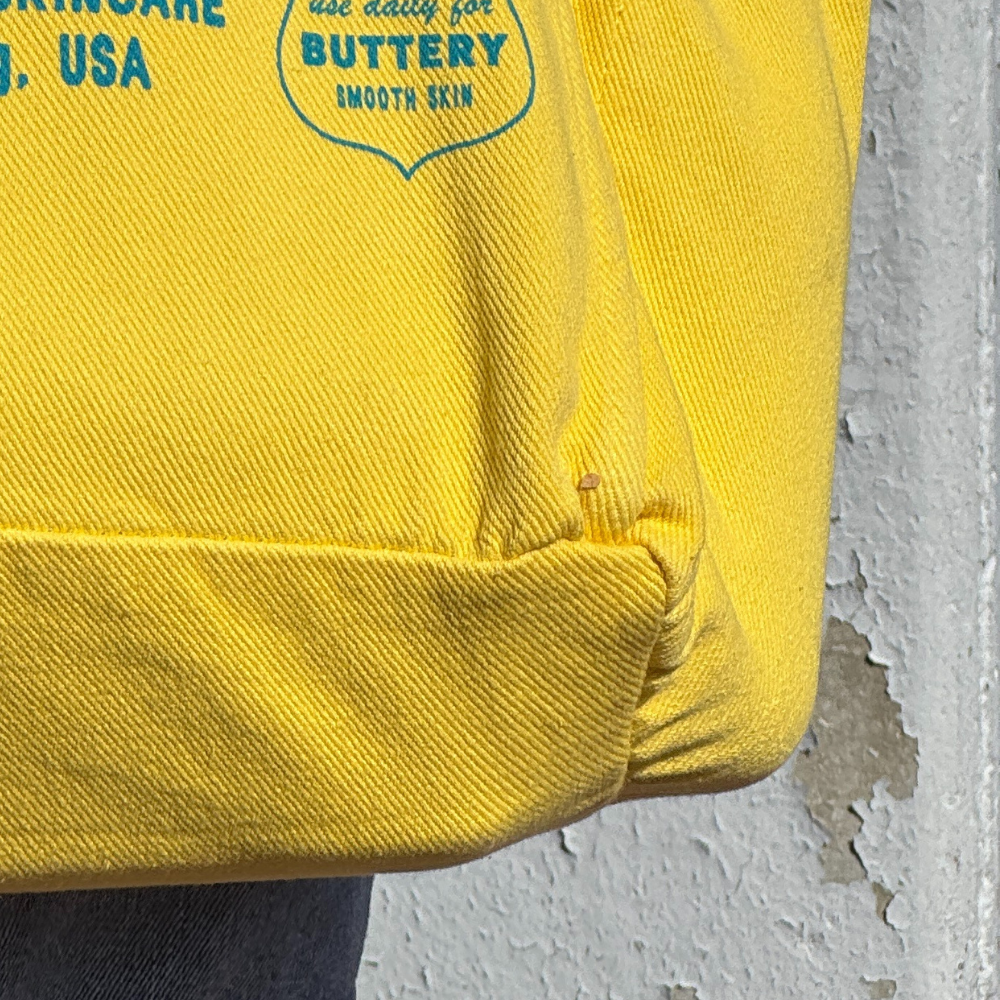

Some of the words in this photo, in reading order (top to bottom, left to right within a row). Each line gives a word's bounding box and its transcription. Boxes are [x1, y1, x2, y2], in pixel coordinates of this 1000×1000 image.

[60, 33, 151, 90] USA
[301, 32, 508, 70] BUTTERY
[336, 84, 416, 111] SMOOTH
[428, 84, 473, 110] SKIN
